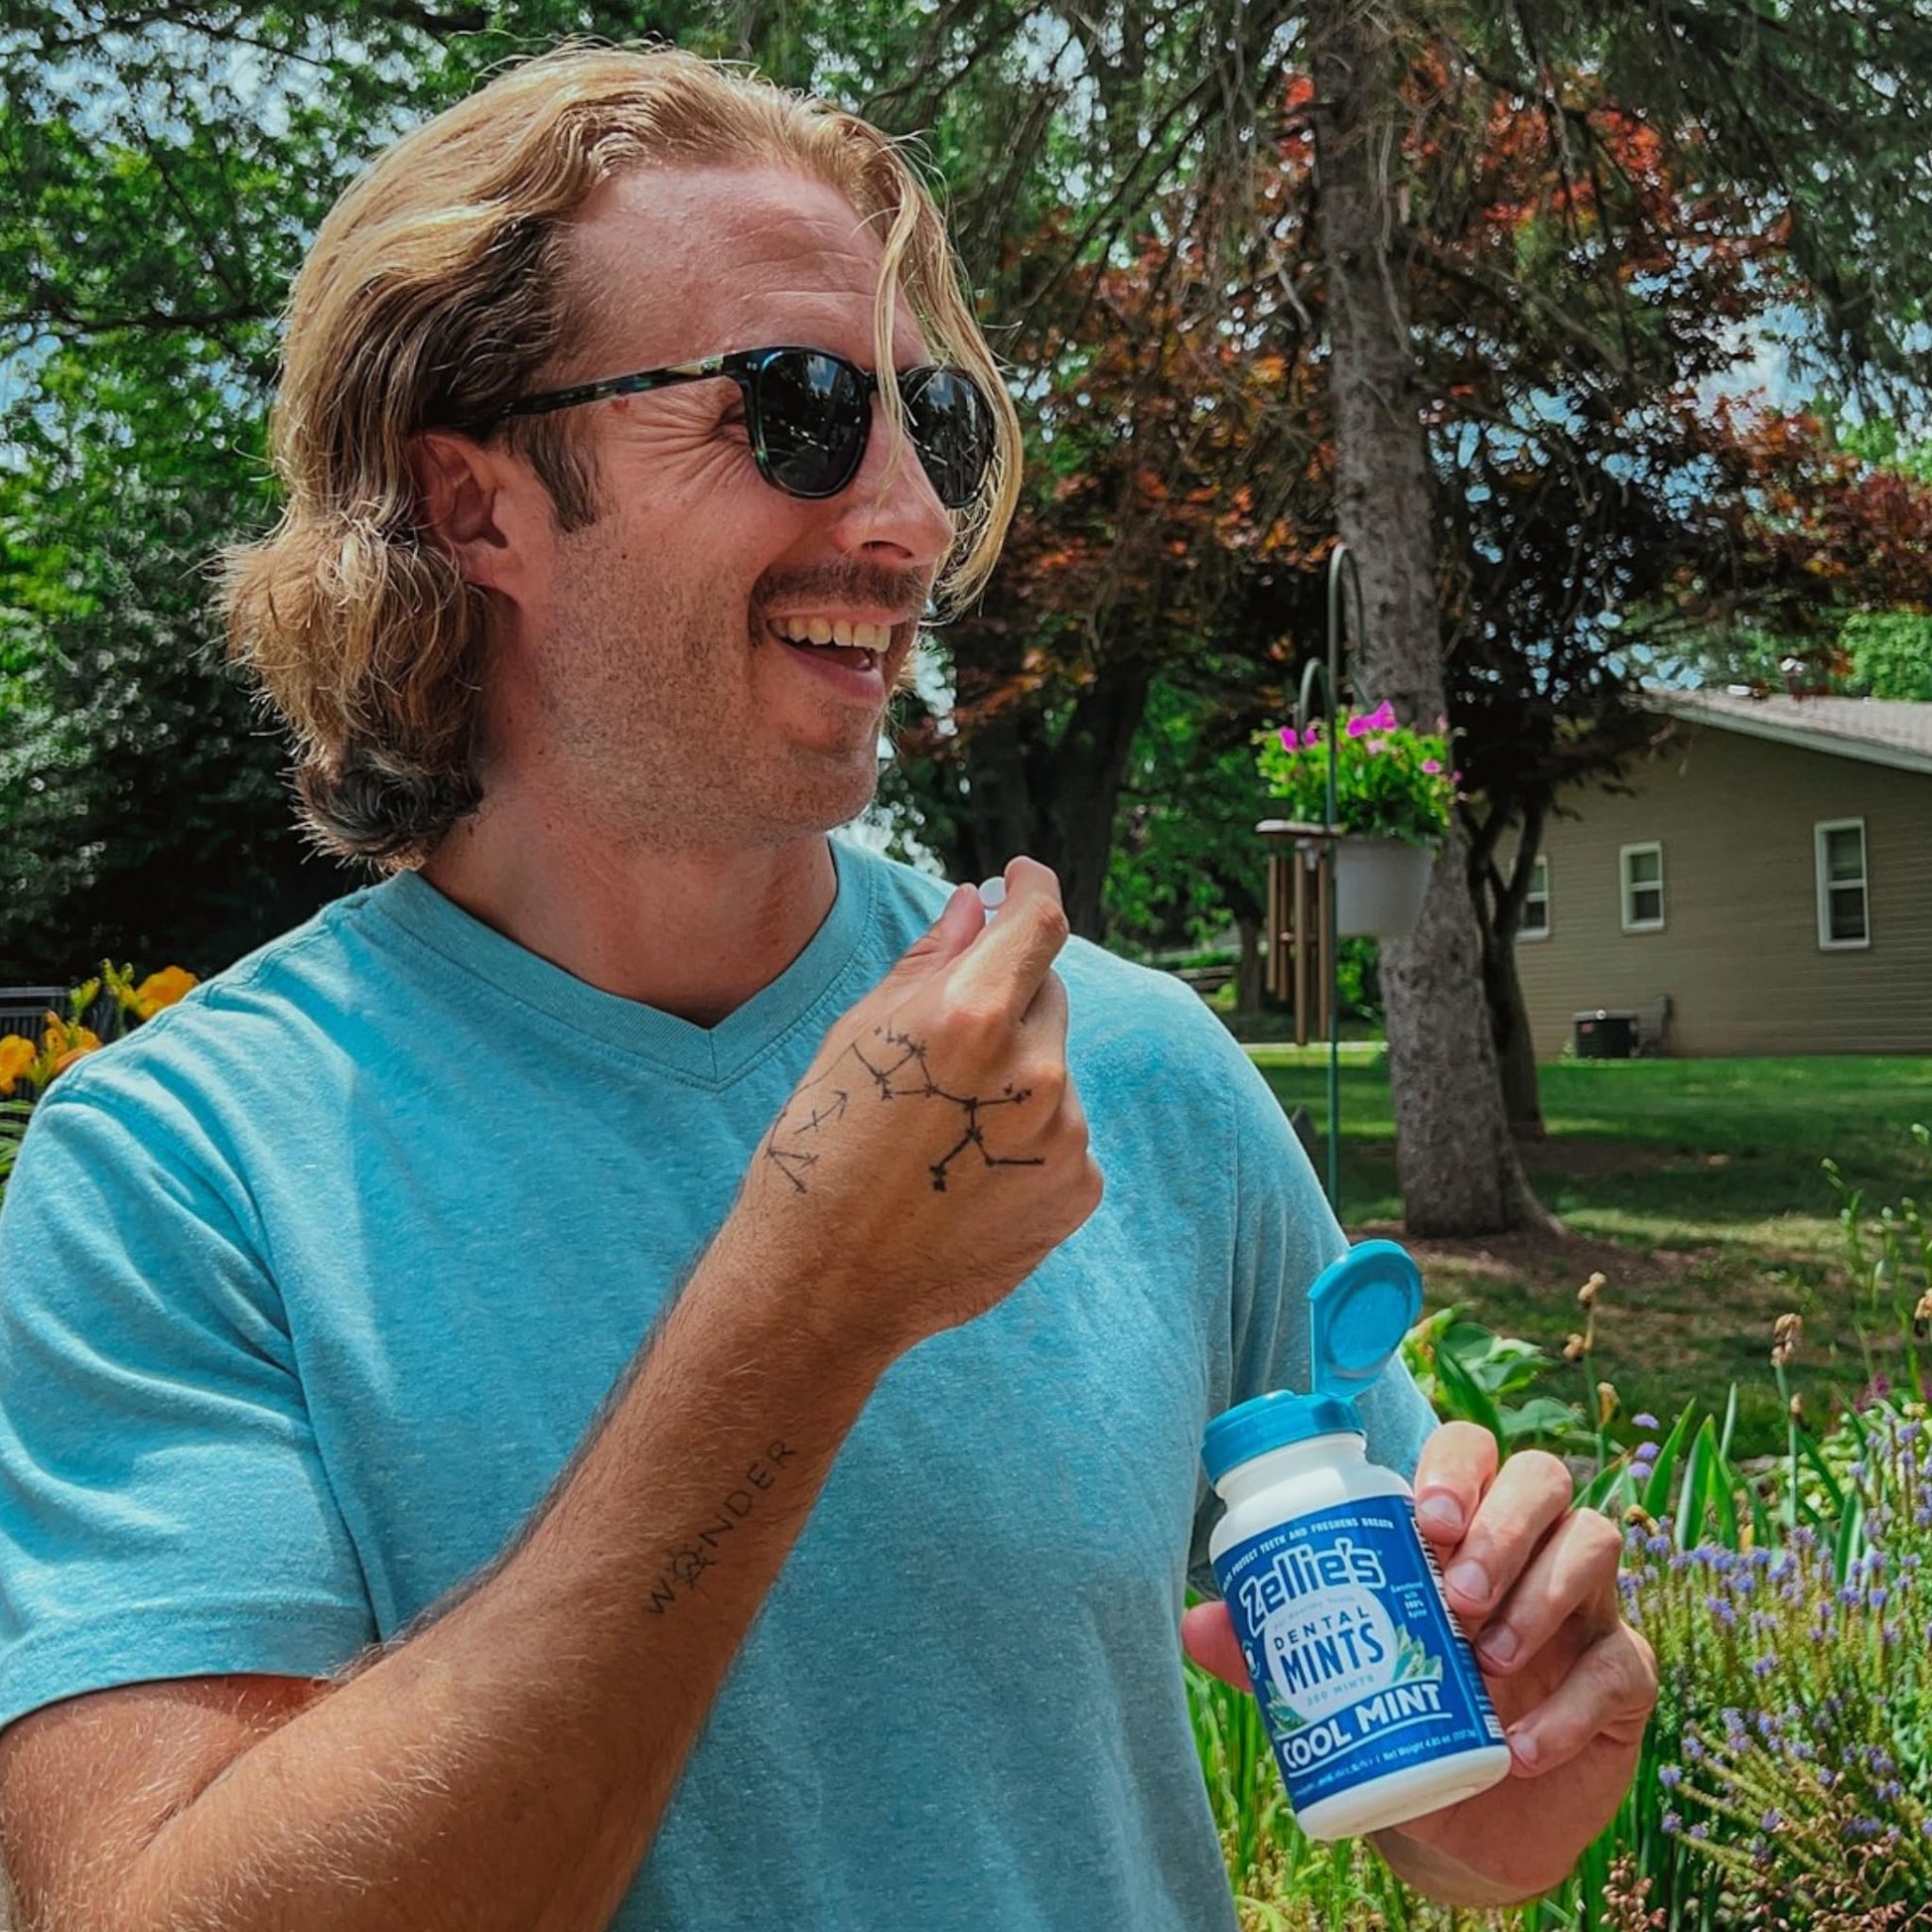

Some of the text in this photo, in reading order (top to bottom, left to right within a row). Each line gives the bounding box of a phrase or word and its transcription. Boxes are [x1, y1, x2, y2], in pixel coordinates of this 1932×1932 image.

[1289, 1528, 1308, 1541] AND
[1311, 1517, 1359, 1534] FRESHENS
[1239, 1537, 1387, 1638] Zellie's
[1274, 1604, 1370, 1651] DENTAL
[1280, 1621, 1384, 1696] MINTS
[1282, 1719, 1352, 1769] COOL
[1355, 1683, 1442, 1733] MINT
